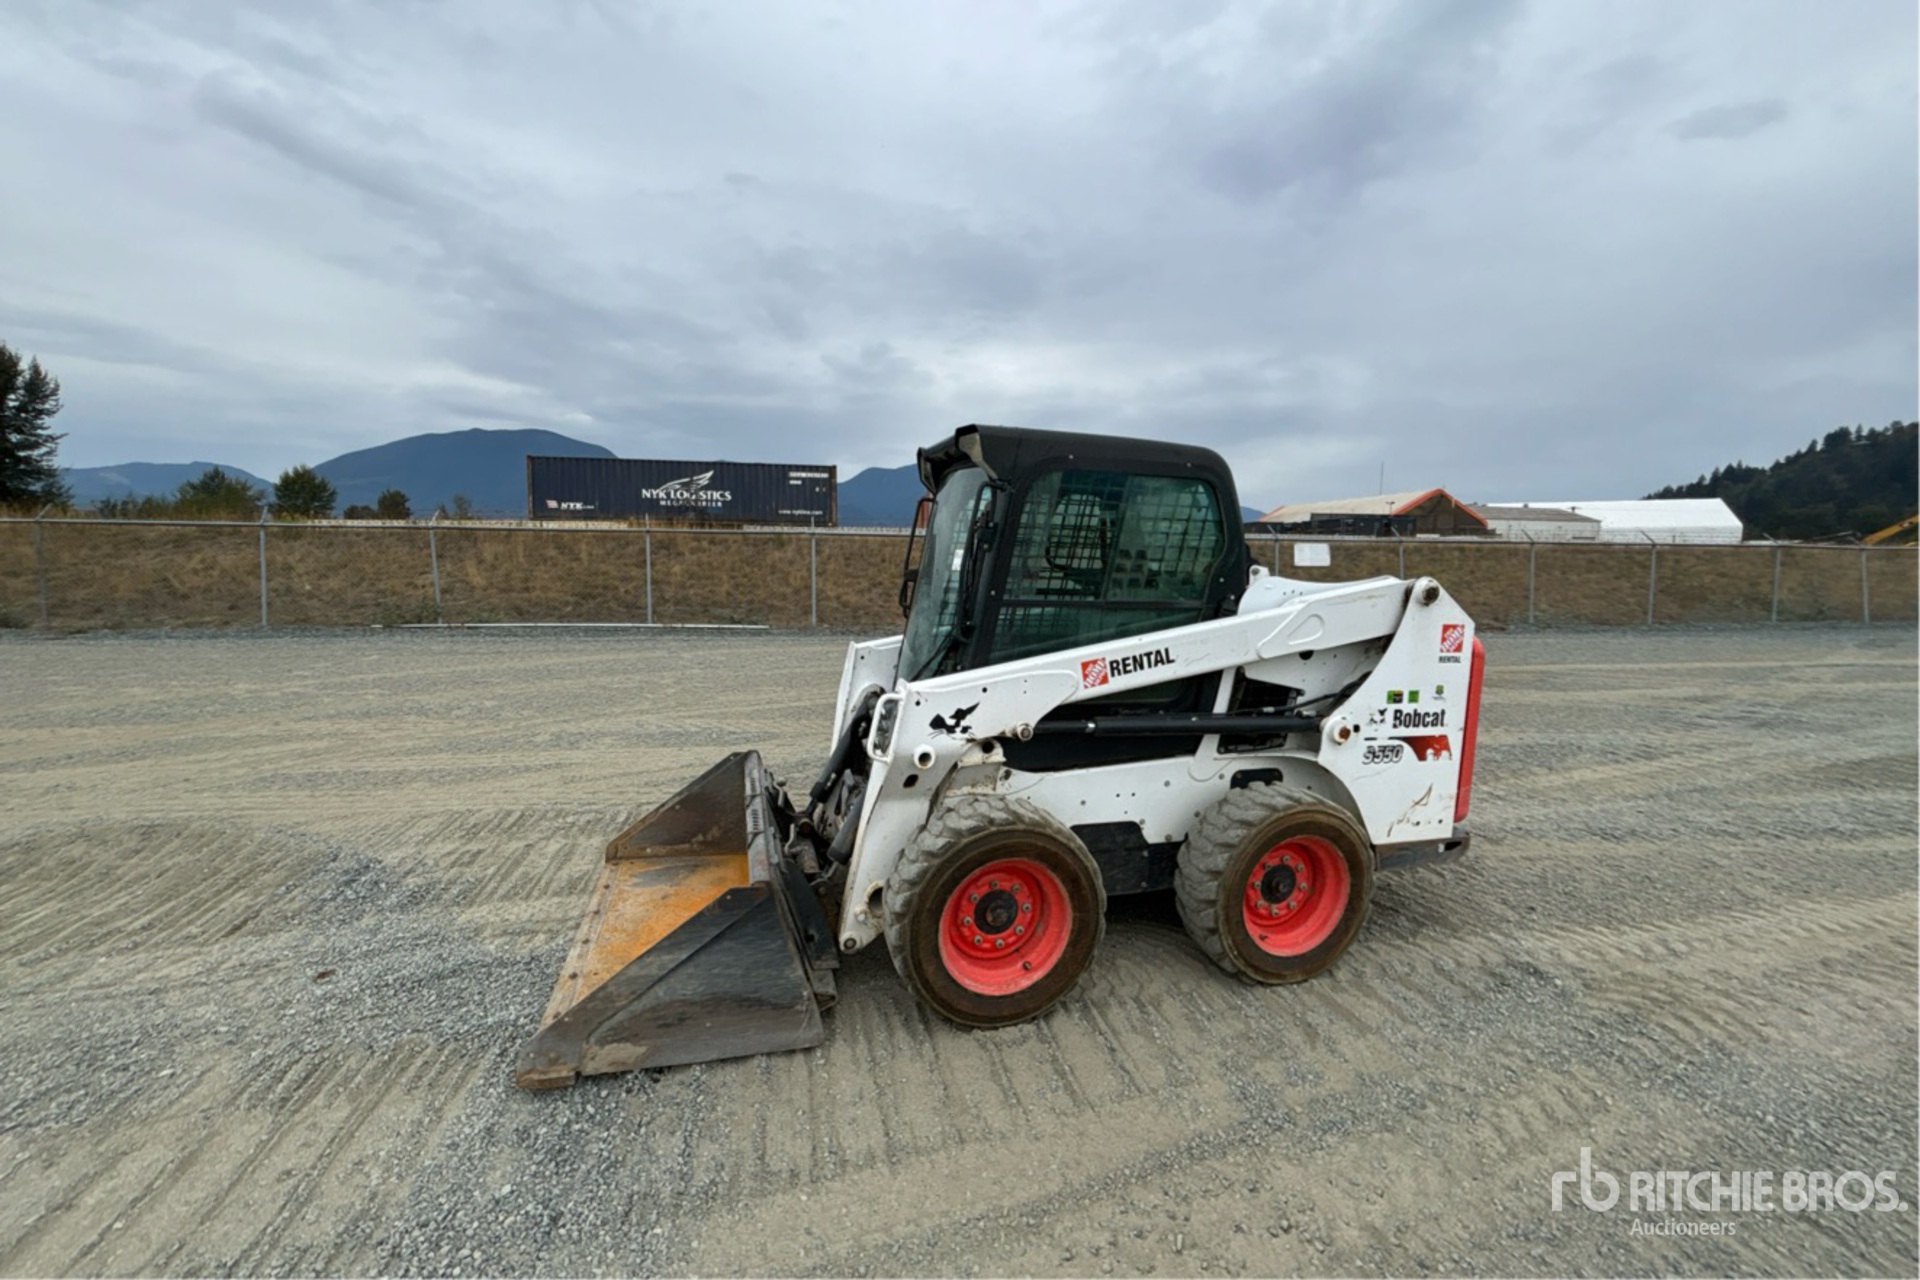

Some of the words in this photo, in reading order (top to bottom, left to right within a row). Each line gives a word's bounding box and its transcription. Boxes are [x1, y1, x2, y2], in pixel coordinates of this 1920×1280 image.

[641, 488, 667, 499] NYK
[668, 489, 732, 502] LOGSTICS
[1109, 647, 1176, 678] RENTAL
[1438, 655, 1462, 664] RENTAL
[1392, 708, 1446, 729] Bobcat
[1361, 744, 1404, 765] S550
